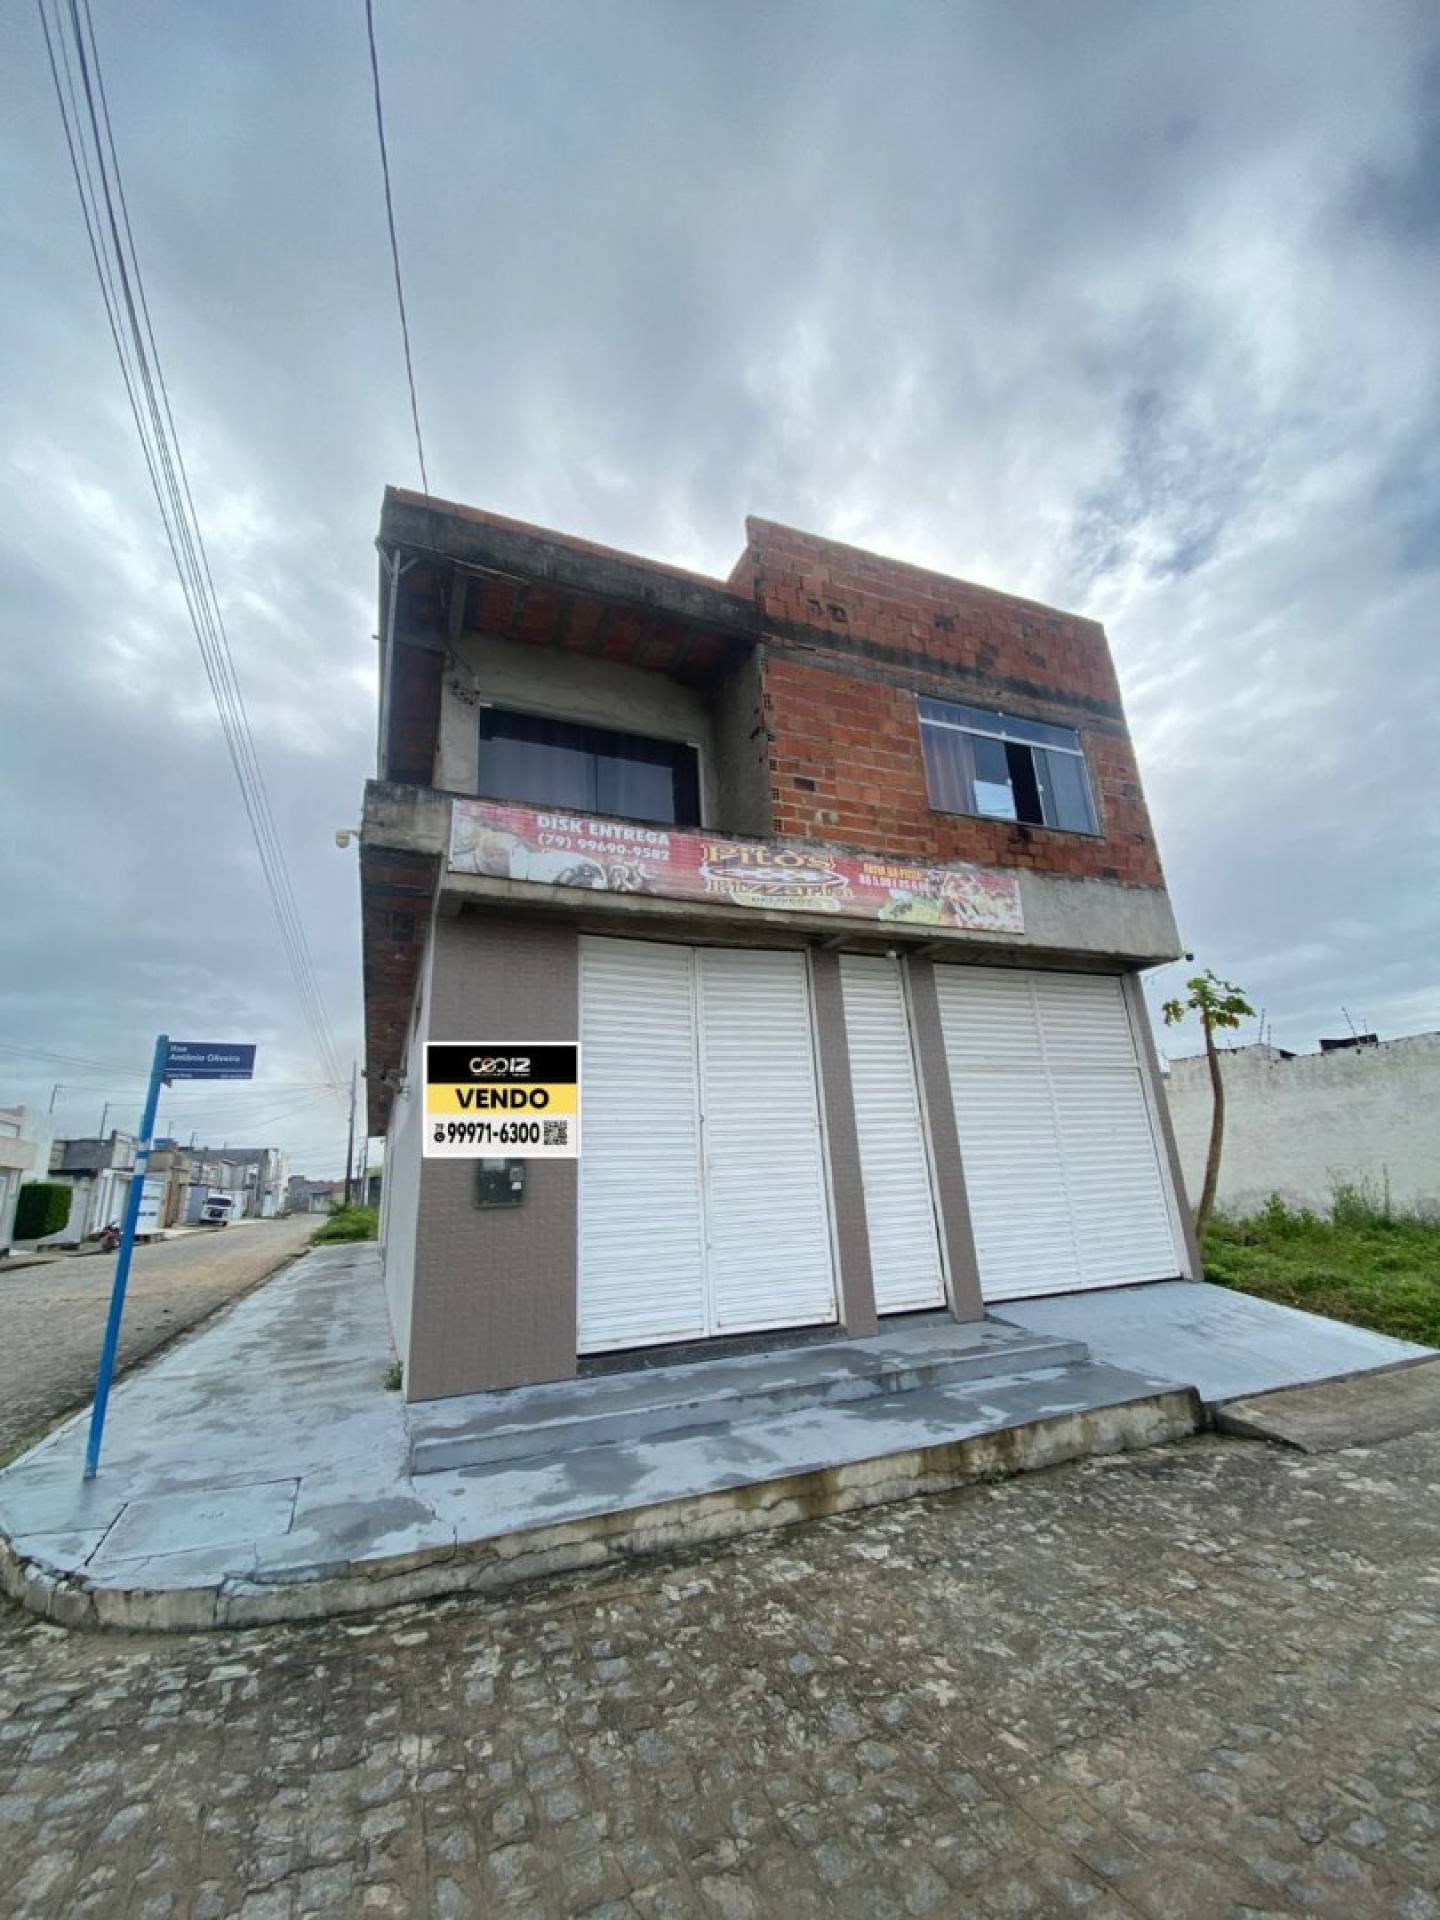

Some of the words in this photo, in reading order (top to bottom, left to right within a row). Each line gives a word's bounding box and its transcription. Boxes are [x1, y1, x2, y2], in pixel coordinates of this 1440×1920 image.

[537, 815, 582, 833] DISK
[589, 823, 669, 845] ENTREGA
[538, 833, 571, 849] (79)
[170, 1045, 187, 1053] Rua
[207, 1053, 241, 1062] Oliveira
